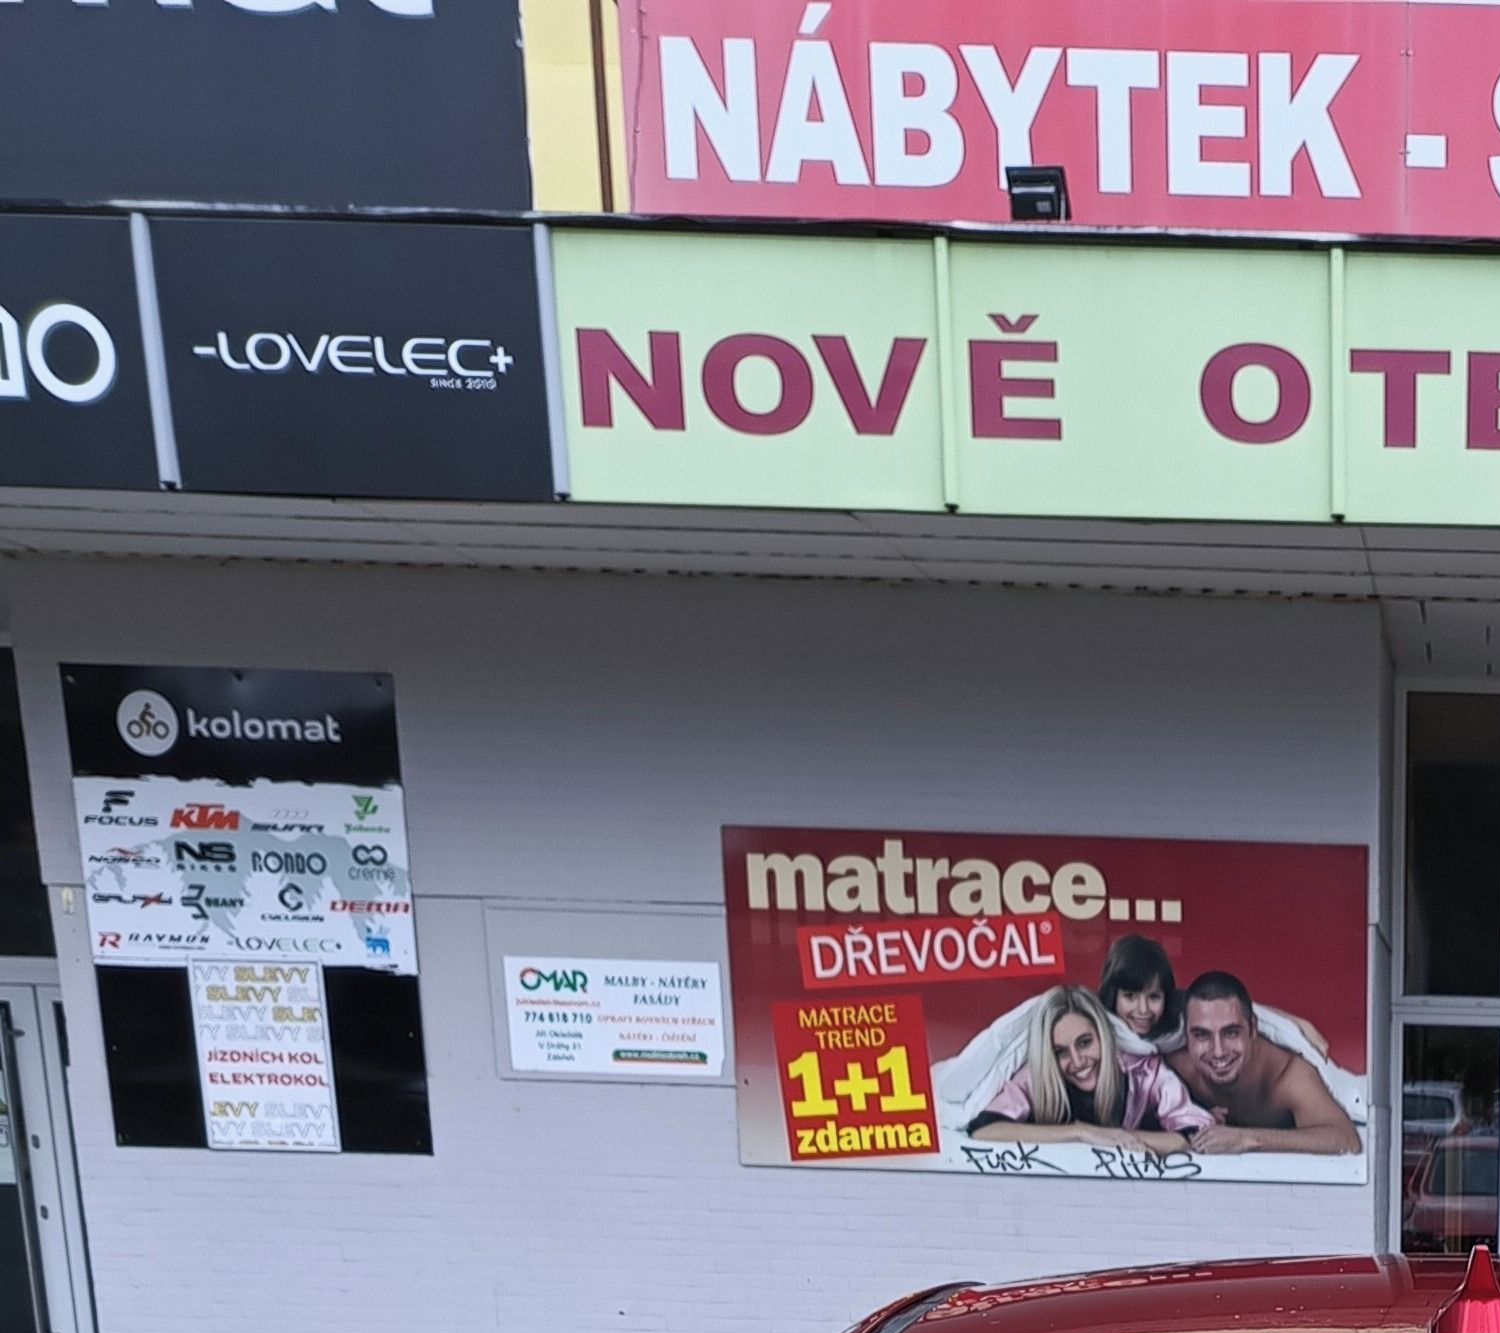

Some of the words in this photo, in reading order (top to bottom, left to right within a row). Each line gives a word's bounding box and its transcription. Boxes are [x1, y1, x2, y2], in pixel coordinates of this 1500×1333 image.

[659, 2, 1362, 200] NÁBYTEK
[465, 377, 497, 390] 2010
[575, 313, 1063, 442] NOVĚ
[187, 707, 342, 744] kolomat
[84, 814, 159, 827] FOCUS
[169, 803, 240, 832] KTM
[174, 840, 237, 863] NS
[233, 966, 310, 984] SLEVY
[519, 966, 588, 994] OMAR
[206, 985, 282, 1003] SLEVY
[798, 1003, 898, 1029] MATRACE
[815, 1028, 887, 1050] TREND
[288, 1054, 325, 1065] KOL
[208, 1072, 329, 1087] ELEKTROKOL
[787, 1045, 928, 1118] 1+1
[795, 1120, 932, 1155] zdarma
